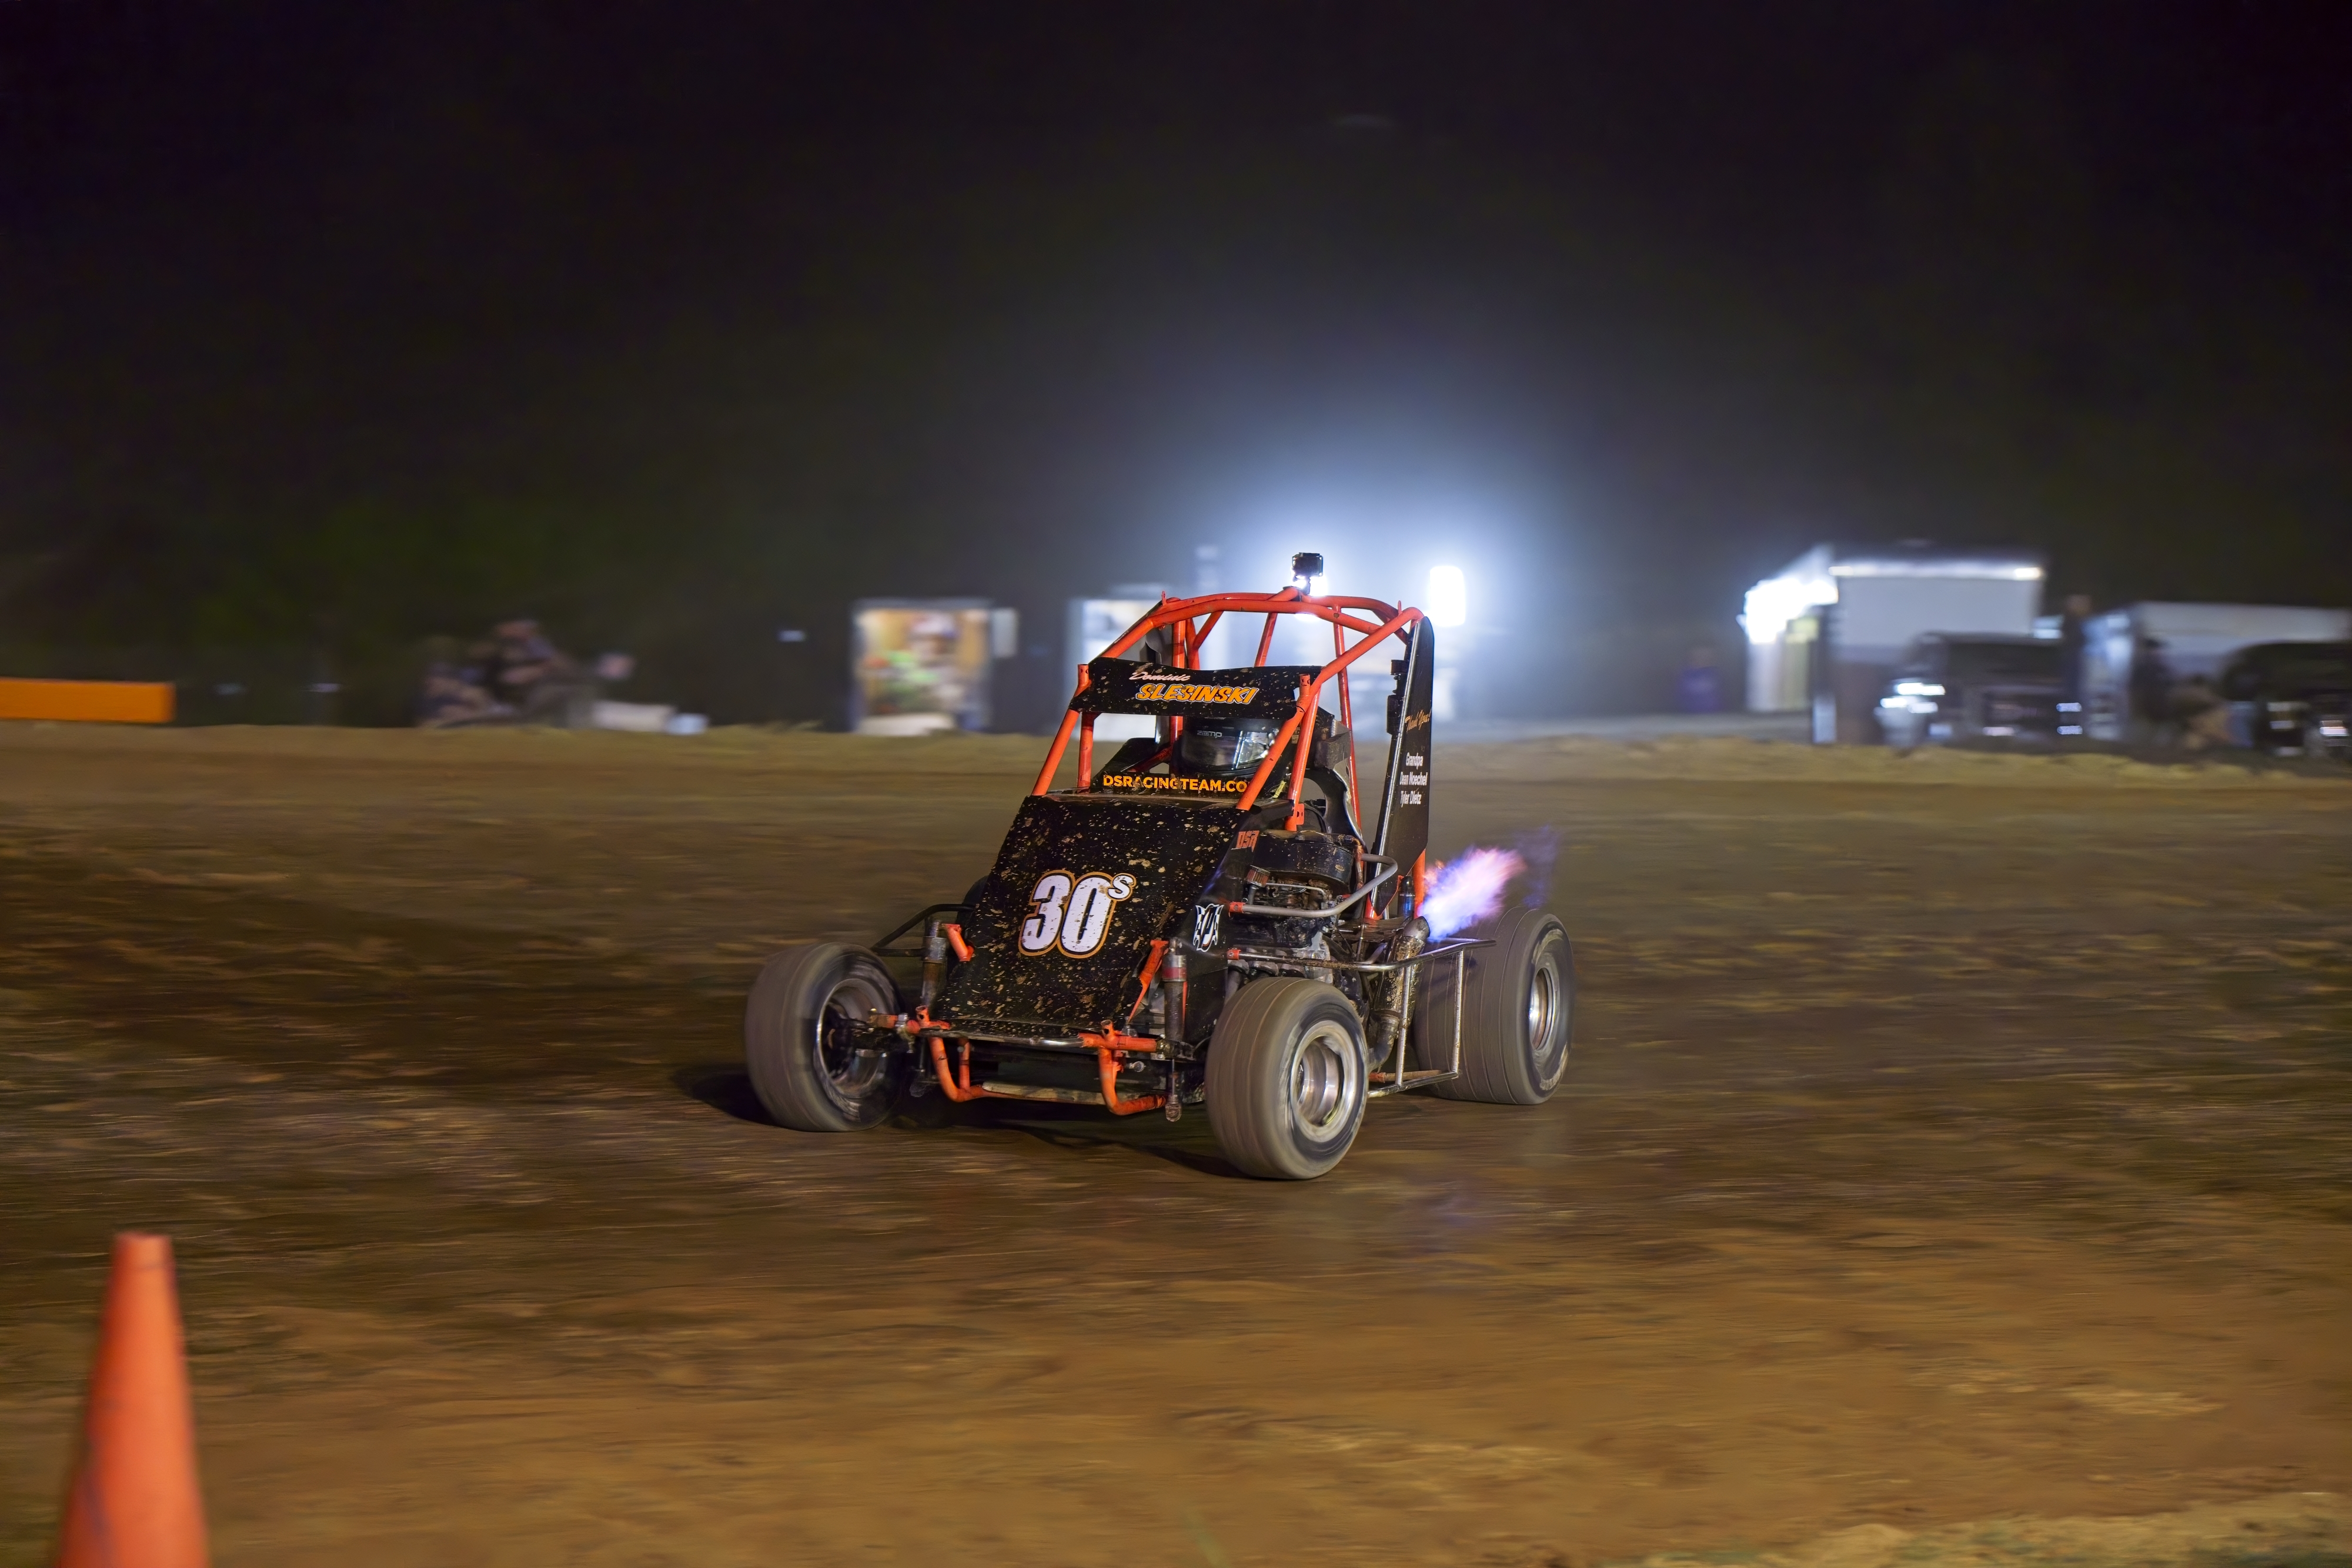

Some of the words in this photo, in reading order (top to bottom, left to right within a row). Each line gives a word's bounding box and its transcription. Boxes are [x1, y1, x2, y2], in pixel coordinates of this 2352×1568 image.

[1129, 671, 1191, 682] Dominic
[1136, 683, 1259, 704] SLESINSKI
[1405, 752, 1424, 770] Grandpa
[1103, 774, 1250, 793] DSRACINGTEAM.CO
[1399, 771, 1409, 785] Dean
[1400, 791, 1410, 808] Tyler
[1409, 791, 1422, 805] Dietz
